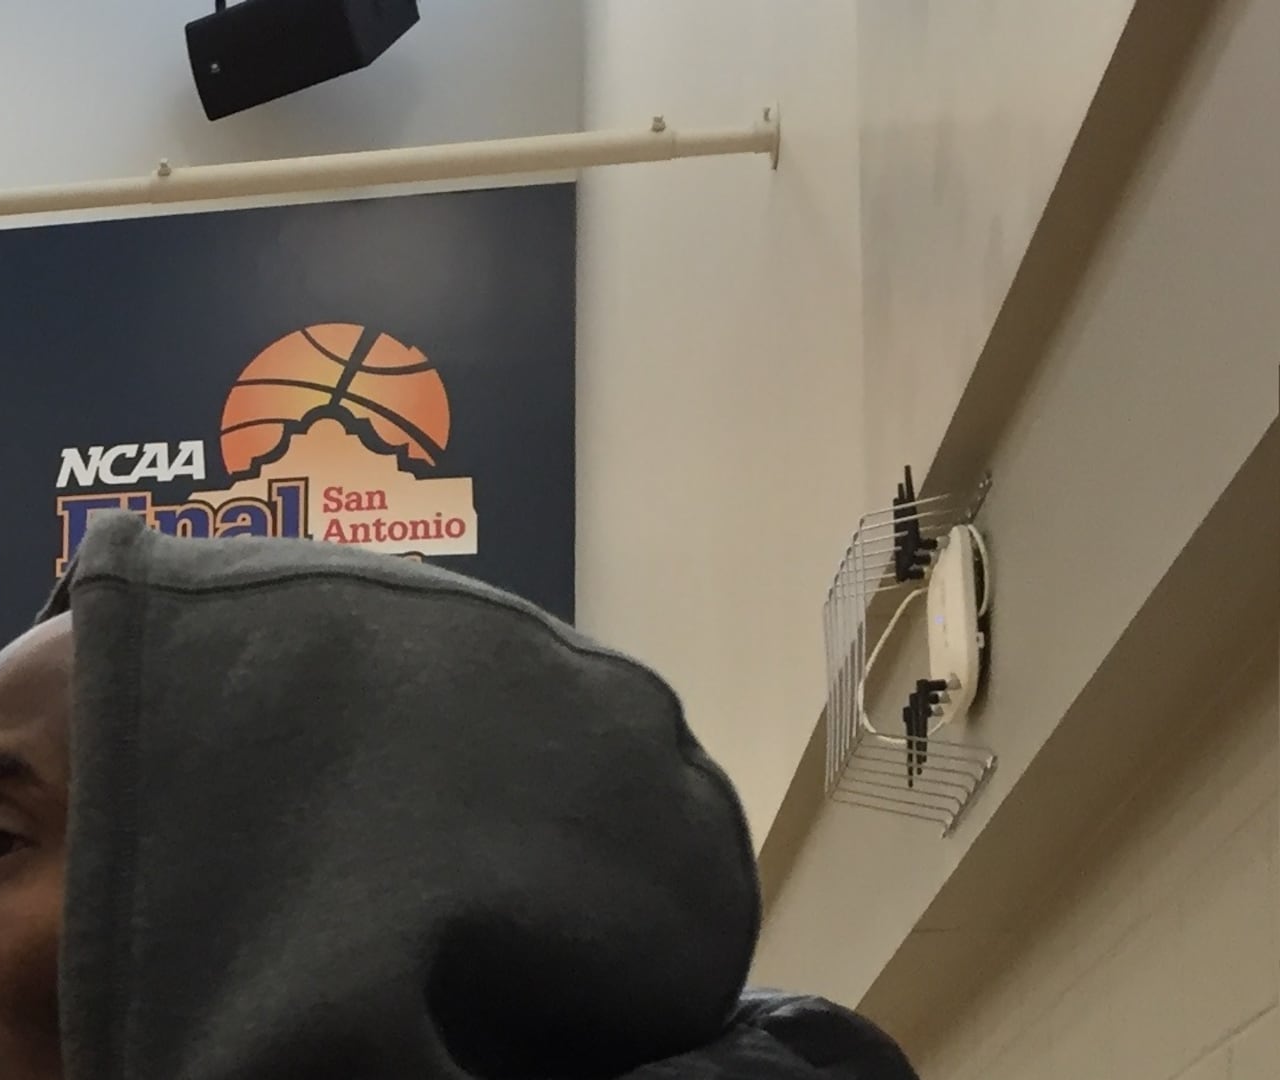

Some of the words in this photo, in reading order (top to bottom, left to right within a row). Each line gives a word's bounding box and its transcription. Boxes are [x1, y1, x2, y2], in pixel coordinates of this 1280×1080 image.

[56, 440, 206, 487] NCAA
[322, 486, 388, 515] San
[322, 512, 466, 543] Antonio
